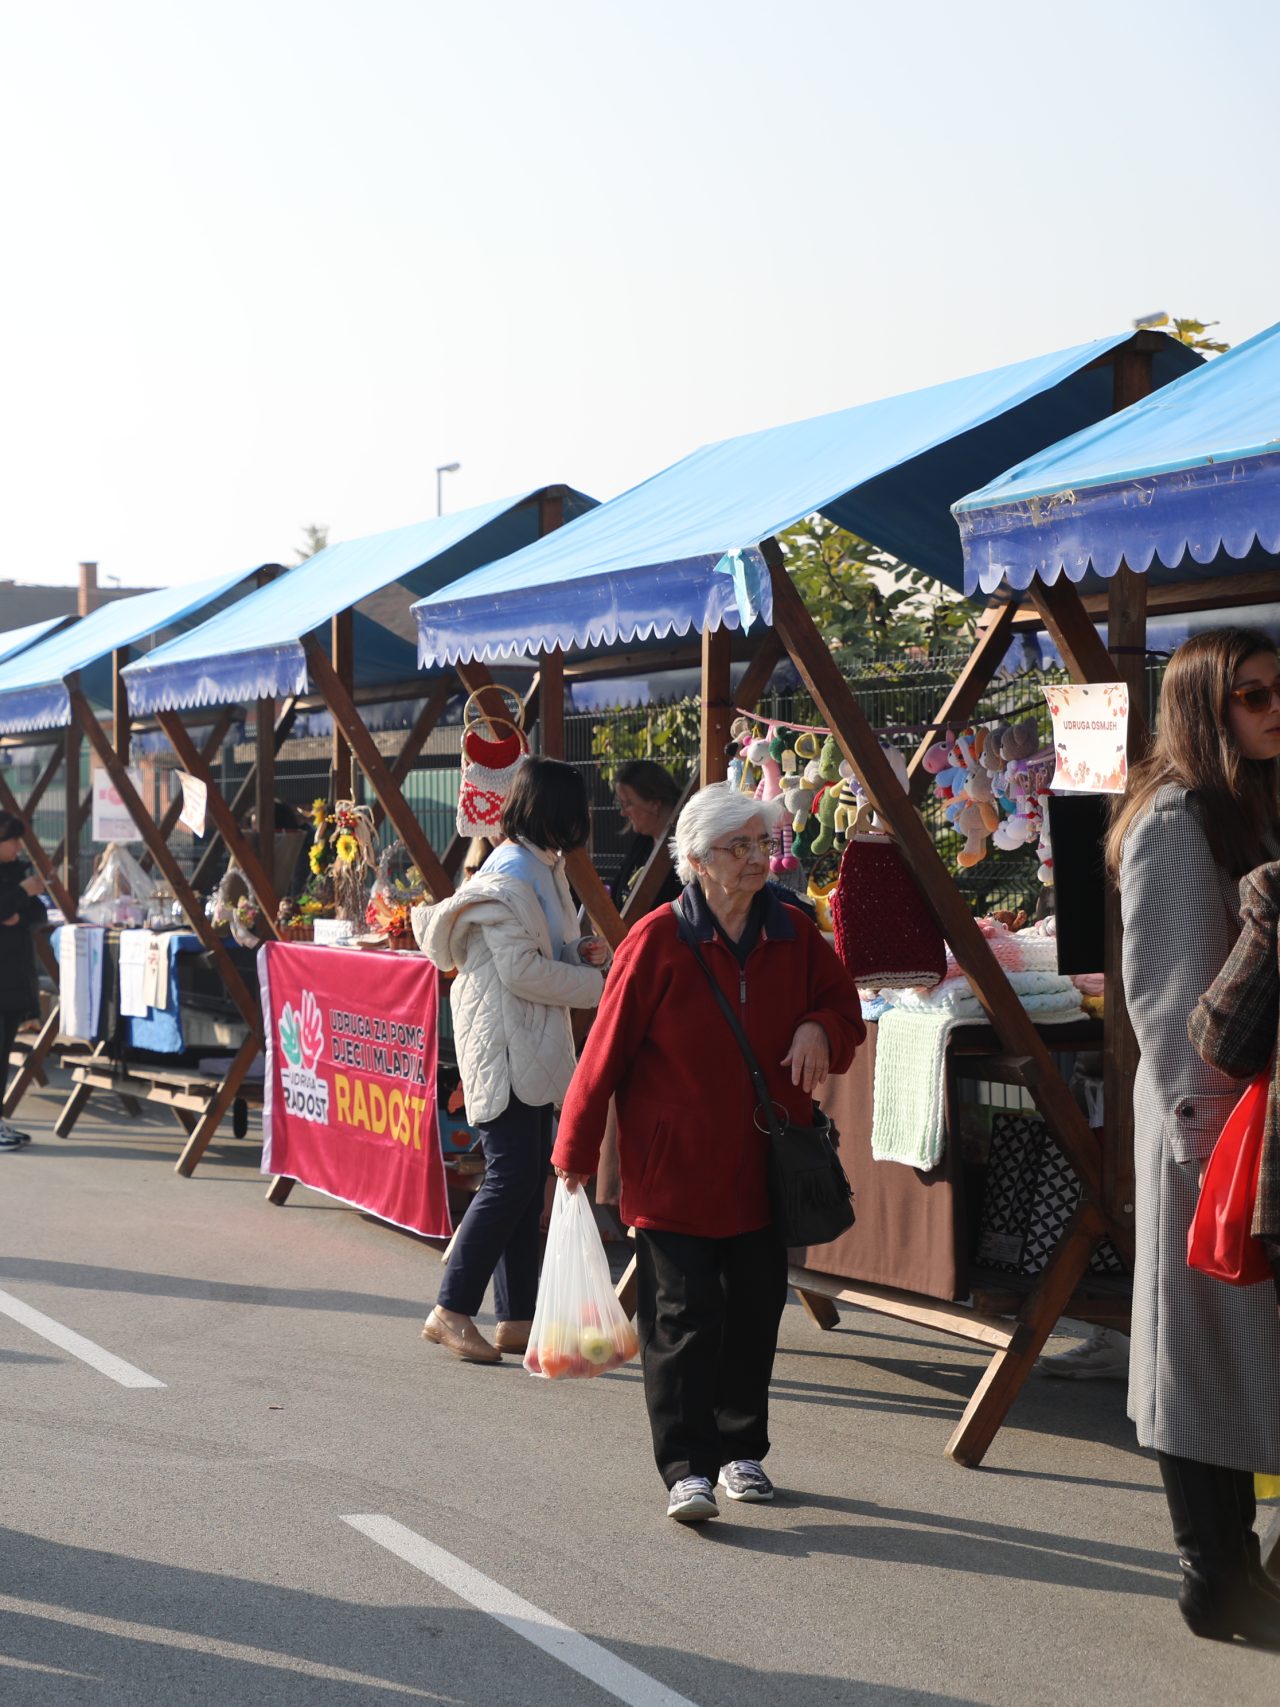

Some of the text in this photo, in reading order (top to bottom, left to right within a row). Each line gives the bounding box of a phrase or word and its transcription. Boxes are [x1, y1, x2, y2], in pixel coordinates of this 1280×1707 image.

[1063, 721, 1117, 731] UDRUGA OSMJEH
[329, 1009, 373, 1040] UDRUGA
[373, 1018, 389, 1044] ZA
[332, 1036, 366, 1069] DJECI
[366, 1044, 373, 1071] I
[283, 1086, 327, 1121] RADOST
[334, 1073, 425, 1150] RADOST
